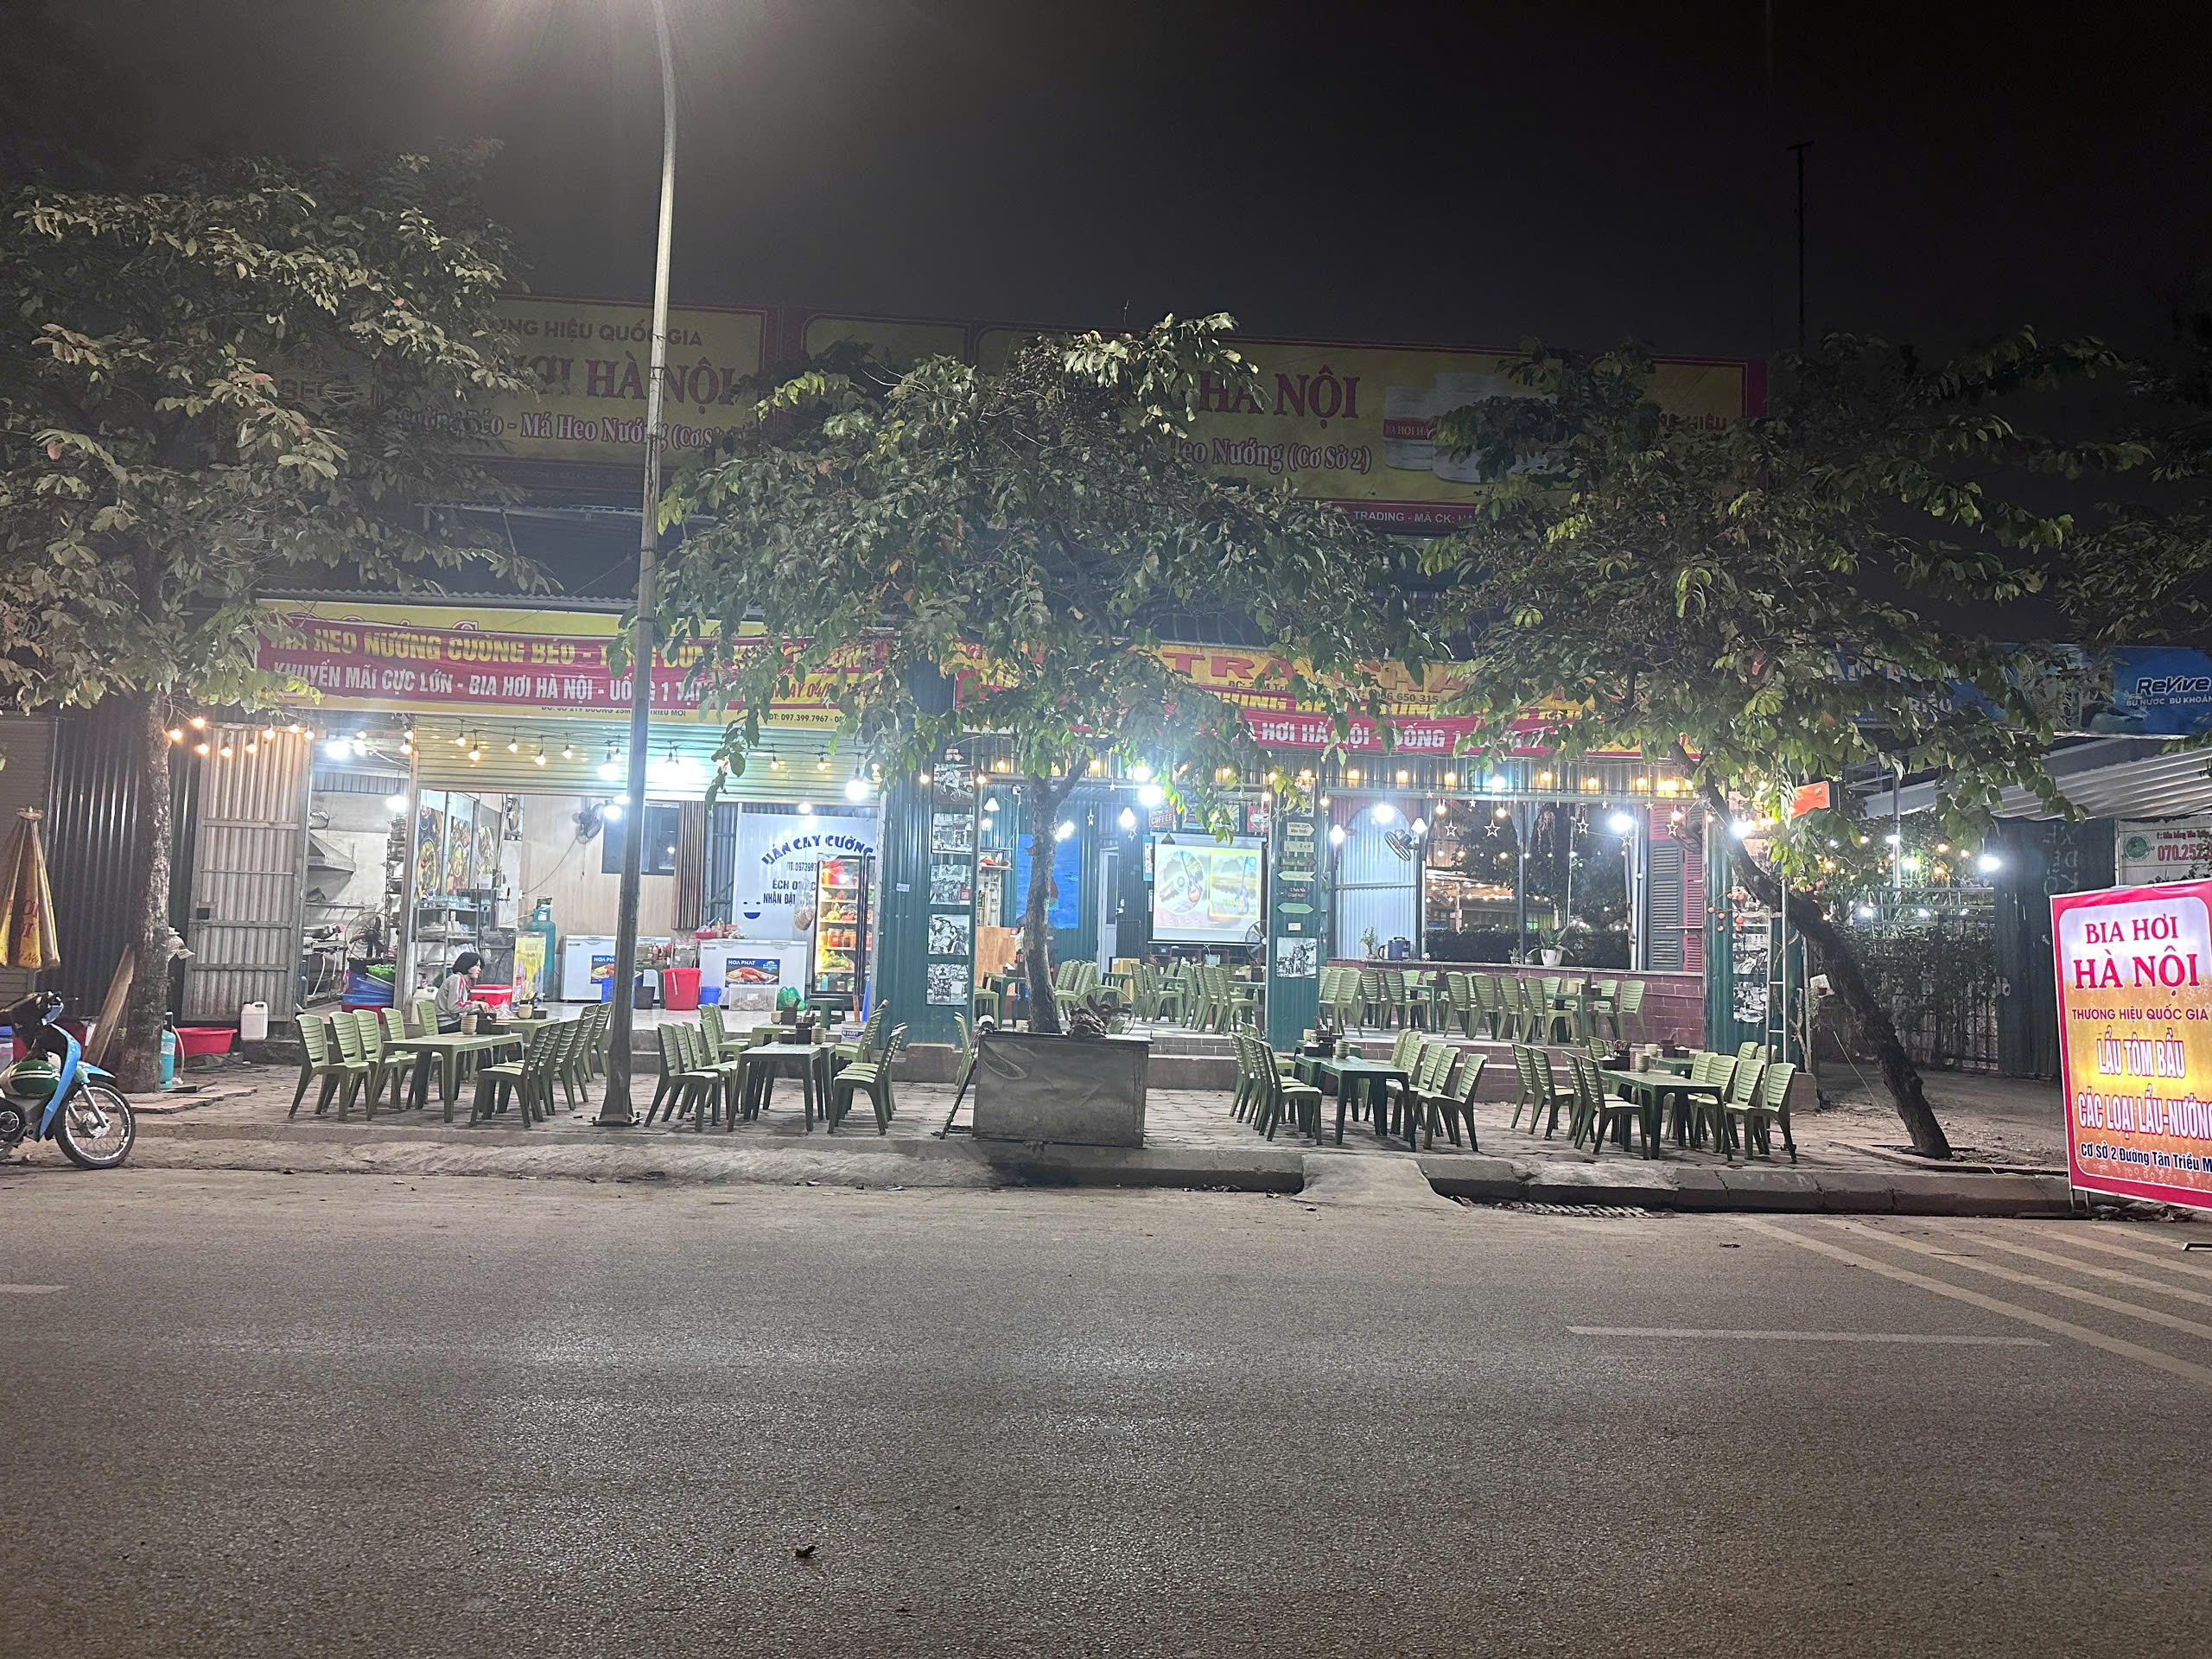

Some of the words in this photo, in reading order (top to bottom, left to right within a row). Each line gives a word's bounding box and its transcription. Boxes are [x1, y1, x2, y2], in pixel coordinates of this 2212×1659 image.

[666, 328, 703, 346] GIA
[585, 351, 647, 399] HÀ
[664, 356, 735, 414] NỘI
[1273, 365, 1361, 429] NỘI
[521, 411, 551, 438] Má
[556, 414, 598, 442] Heo
[1213, 438, 1284, 474] Nướng
[1287, 443, 1322, 471] (Cơ
[1323, 442, 1349, 470] Sở
[1350, 445, 1372, 474] 2)
[1353, 511, 1404, 522] TRADING
[1414, 511, 1432, 523] MÃ
[314, 628, 358, 654] HEO
[531, 637, 575, 664] BÉO
[346, 664, 377, 690] MÃI
[382, 669, 415, 696] CỰC
[420, 669, 453, 694] LỚN
[469, 675, 497, 696] BIA
[502, 674, 531, 698] HƠI
[536, 673, 558, 699] HÀ
[563, 675, 593, 704] NỘI
[609, 673, 656, 701] UỐG
[661, 682, 669, 702] 1
[1397, 692, 1415, 702] 650
[1419, 694, 1439, 703] 315
[2170, 695, 2181, 704] BÙ
[1262, 721, 1295, 741] HƠI
[1302, 721, 1328, 743] HÀ
[1151, 814, 1174, 824] COFFEE
[793, 835, 822, 850] CAY
[2085, 921, 2126, 944] BIA
[2132, 913, 2179, 941] HƠI
[2074, 949, 2123, 989] HÀ
[2133, 945, 2200, 996] NỘI
[2072, 1007, 2116, 1020] THƯƠNG
[2120, 1006, 2143, 1023] HIỆU
[2146, 1003, 2183, 1020] QUỐC
[2185, 1009, 2209, 1020] GIA
[2123, 1032, 2155, 1077] TÔM
[2077, 1086, 2103, 1129] CÁC
[2105, 1094, 2136, 1140] LOẠI
[2111, 1147, 2117, 1160] 2
[2119, 1147, 2150, 1166] Đường
[2152, 1152, 2171, 1166] Tân
[2173, 1154, 2200, 1171] Triều
